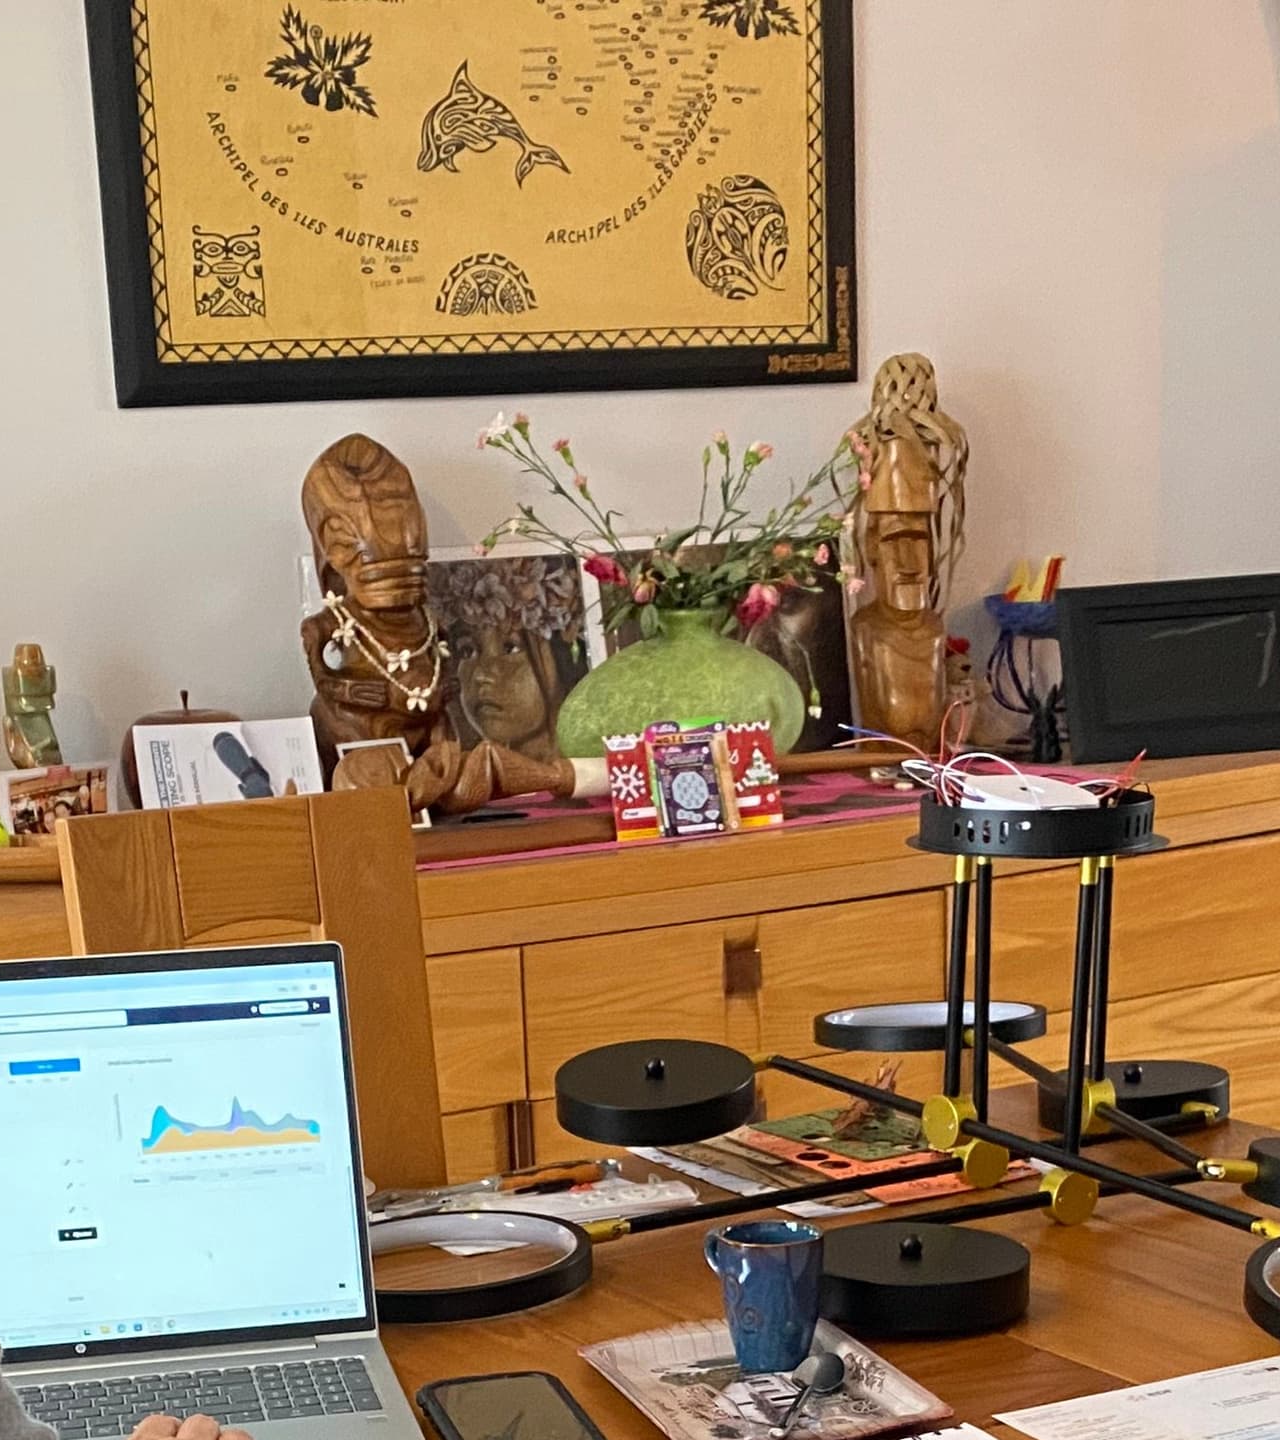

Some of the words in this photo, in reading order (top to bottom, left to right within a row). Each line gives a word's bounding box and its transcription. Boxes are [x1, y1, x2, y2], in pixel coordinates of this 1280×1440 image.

[206, 111, 262, 193] ARCHIPEL
[261, 190, 289, 217] DES
[293, 210, 328, 235] ILES
[335, 227, 419, 253] AUSTRALES
[545, 215, 621, 244] ARCHIPEL
[624, 195, 647, 222] DES
[648, 166, 673, 200] ILES
[670, 92, 718, 167] GAMBIERS
